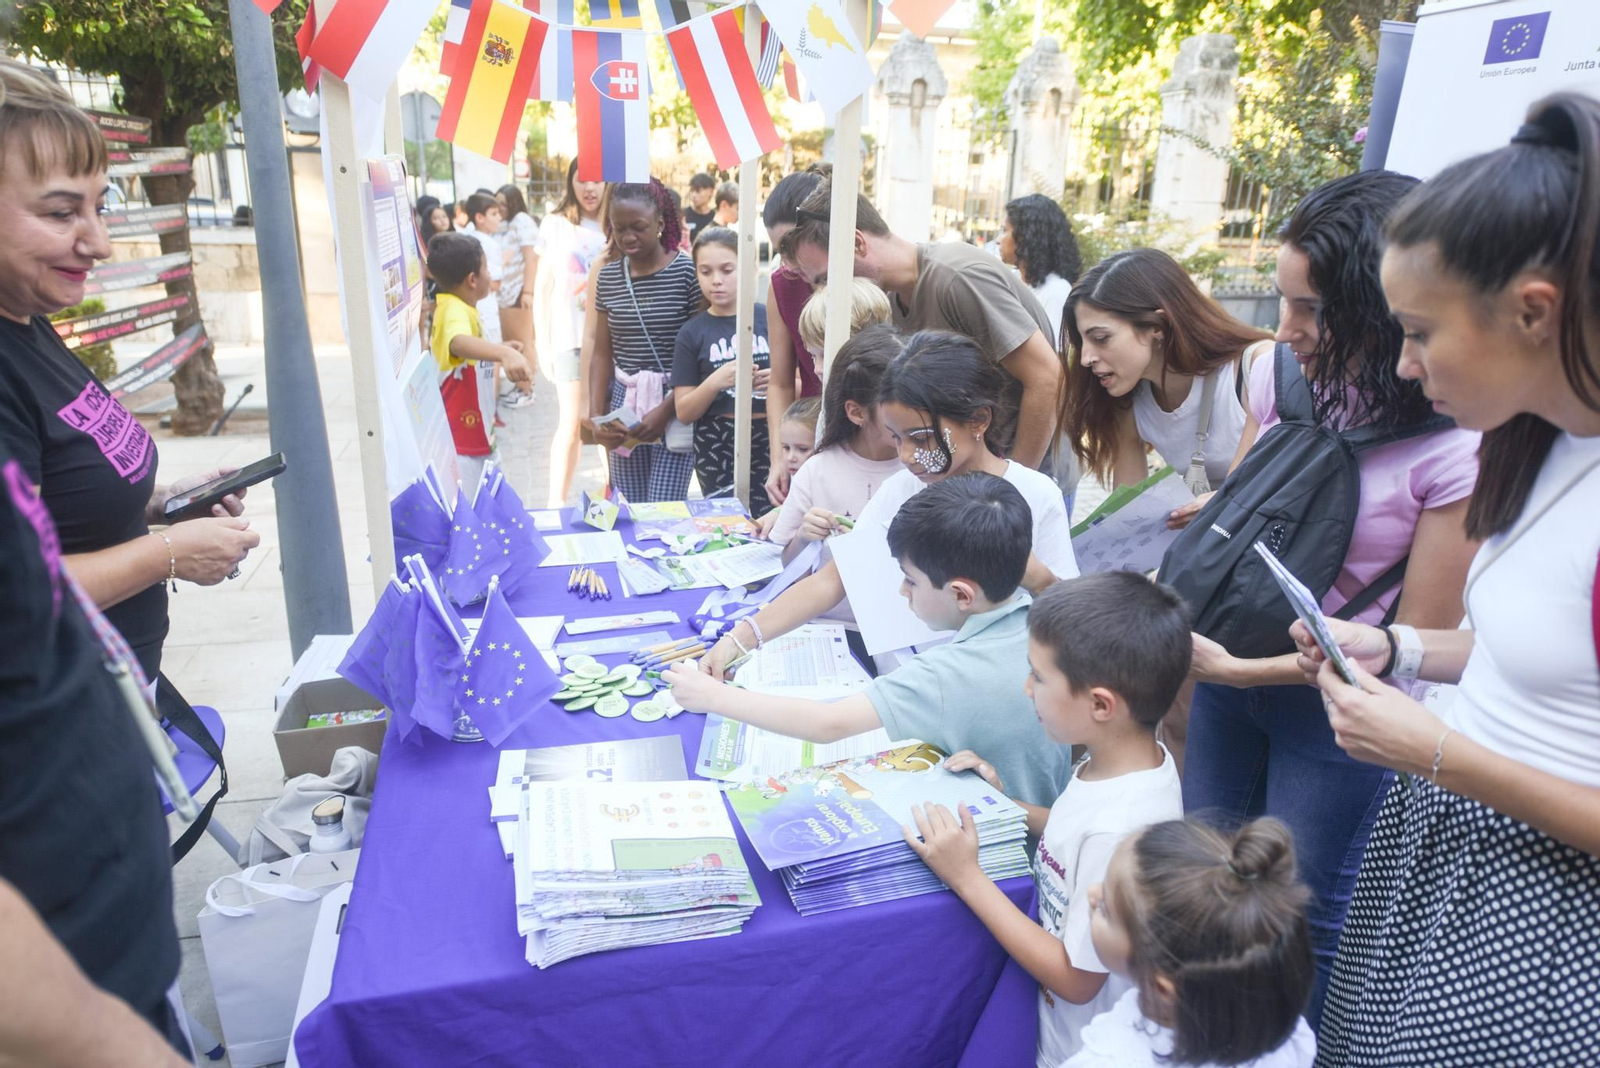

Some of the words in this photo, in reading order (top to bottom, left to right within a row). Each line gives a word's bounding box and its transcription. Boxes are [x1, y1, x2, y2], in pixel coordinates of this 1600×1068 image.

[1480, 66, 1502, 78] Unión
[1504, 65, 1537, 76] Europea
[1564, 61, 1595, 72] Junta
[64, 408, 91, 428] LA
[716, 723, 731, 760] MISIONES
[814, 802, 852, 835] explorar
[835, 800, 880, 835] Europa!
